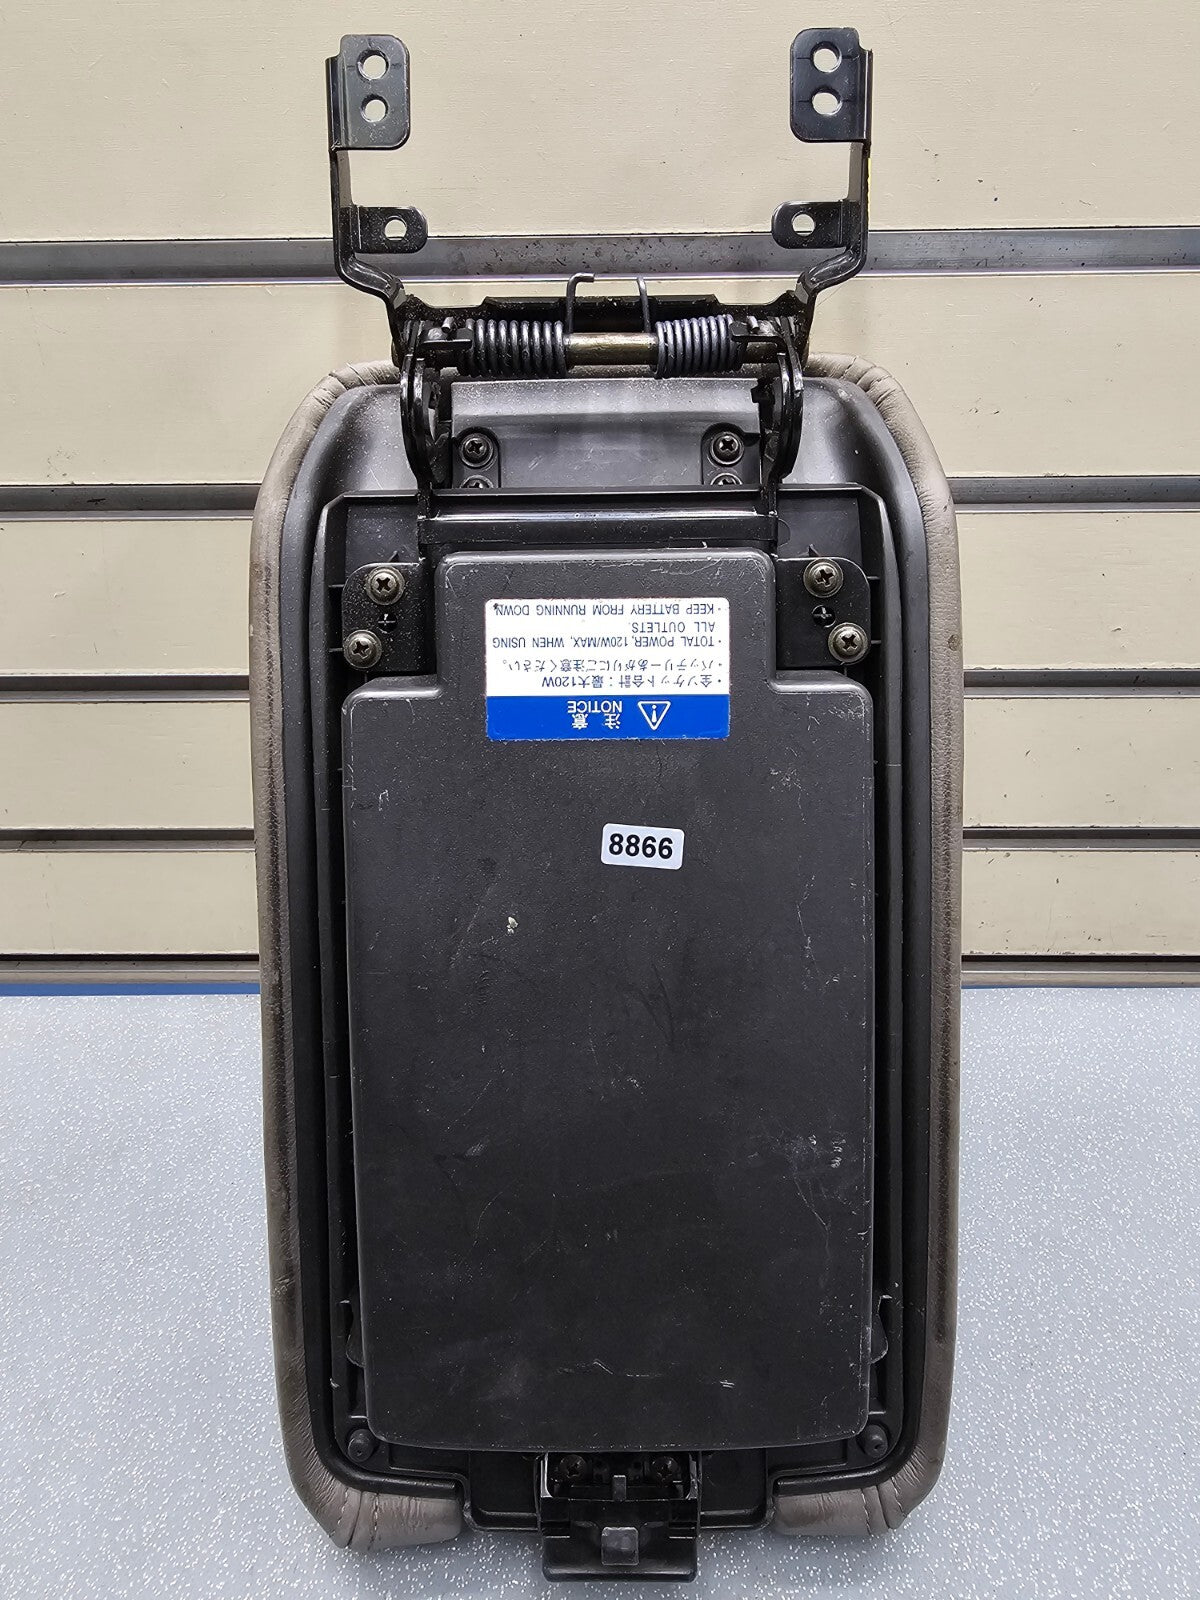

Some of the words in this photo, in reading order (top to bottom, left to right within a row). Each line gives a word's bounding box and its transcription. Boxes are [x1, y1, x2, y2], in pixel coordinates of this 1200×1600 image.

[536, 605, 586, 615] RUNNING
[593, 604, 624, 615] FROM
[630, 604, 679, 615] BATTERY
[686, 604, 714, 614] KEEP
[694, 622, 715, 632] ALL
[492, 638, 525, 648] USING
[532, 638, 564, 648] WHEN
[570, 636, 628, 648] 120W/MAX,
[632, 635, 675, 647] POWER,
[680, 636, 714, 647] TOTAL
[567, 700, 623, 713] NOTICE
[609, 833, 673, 859] 8866
